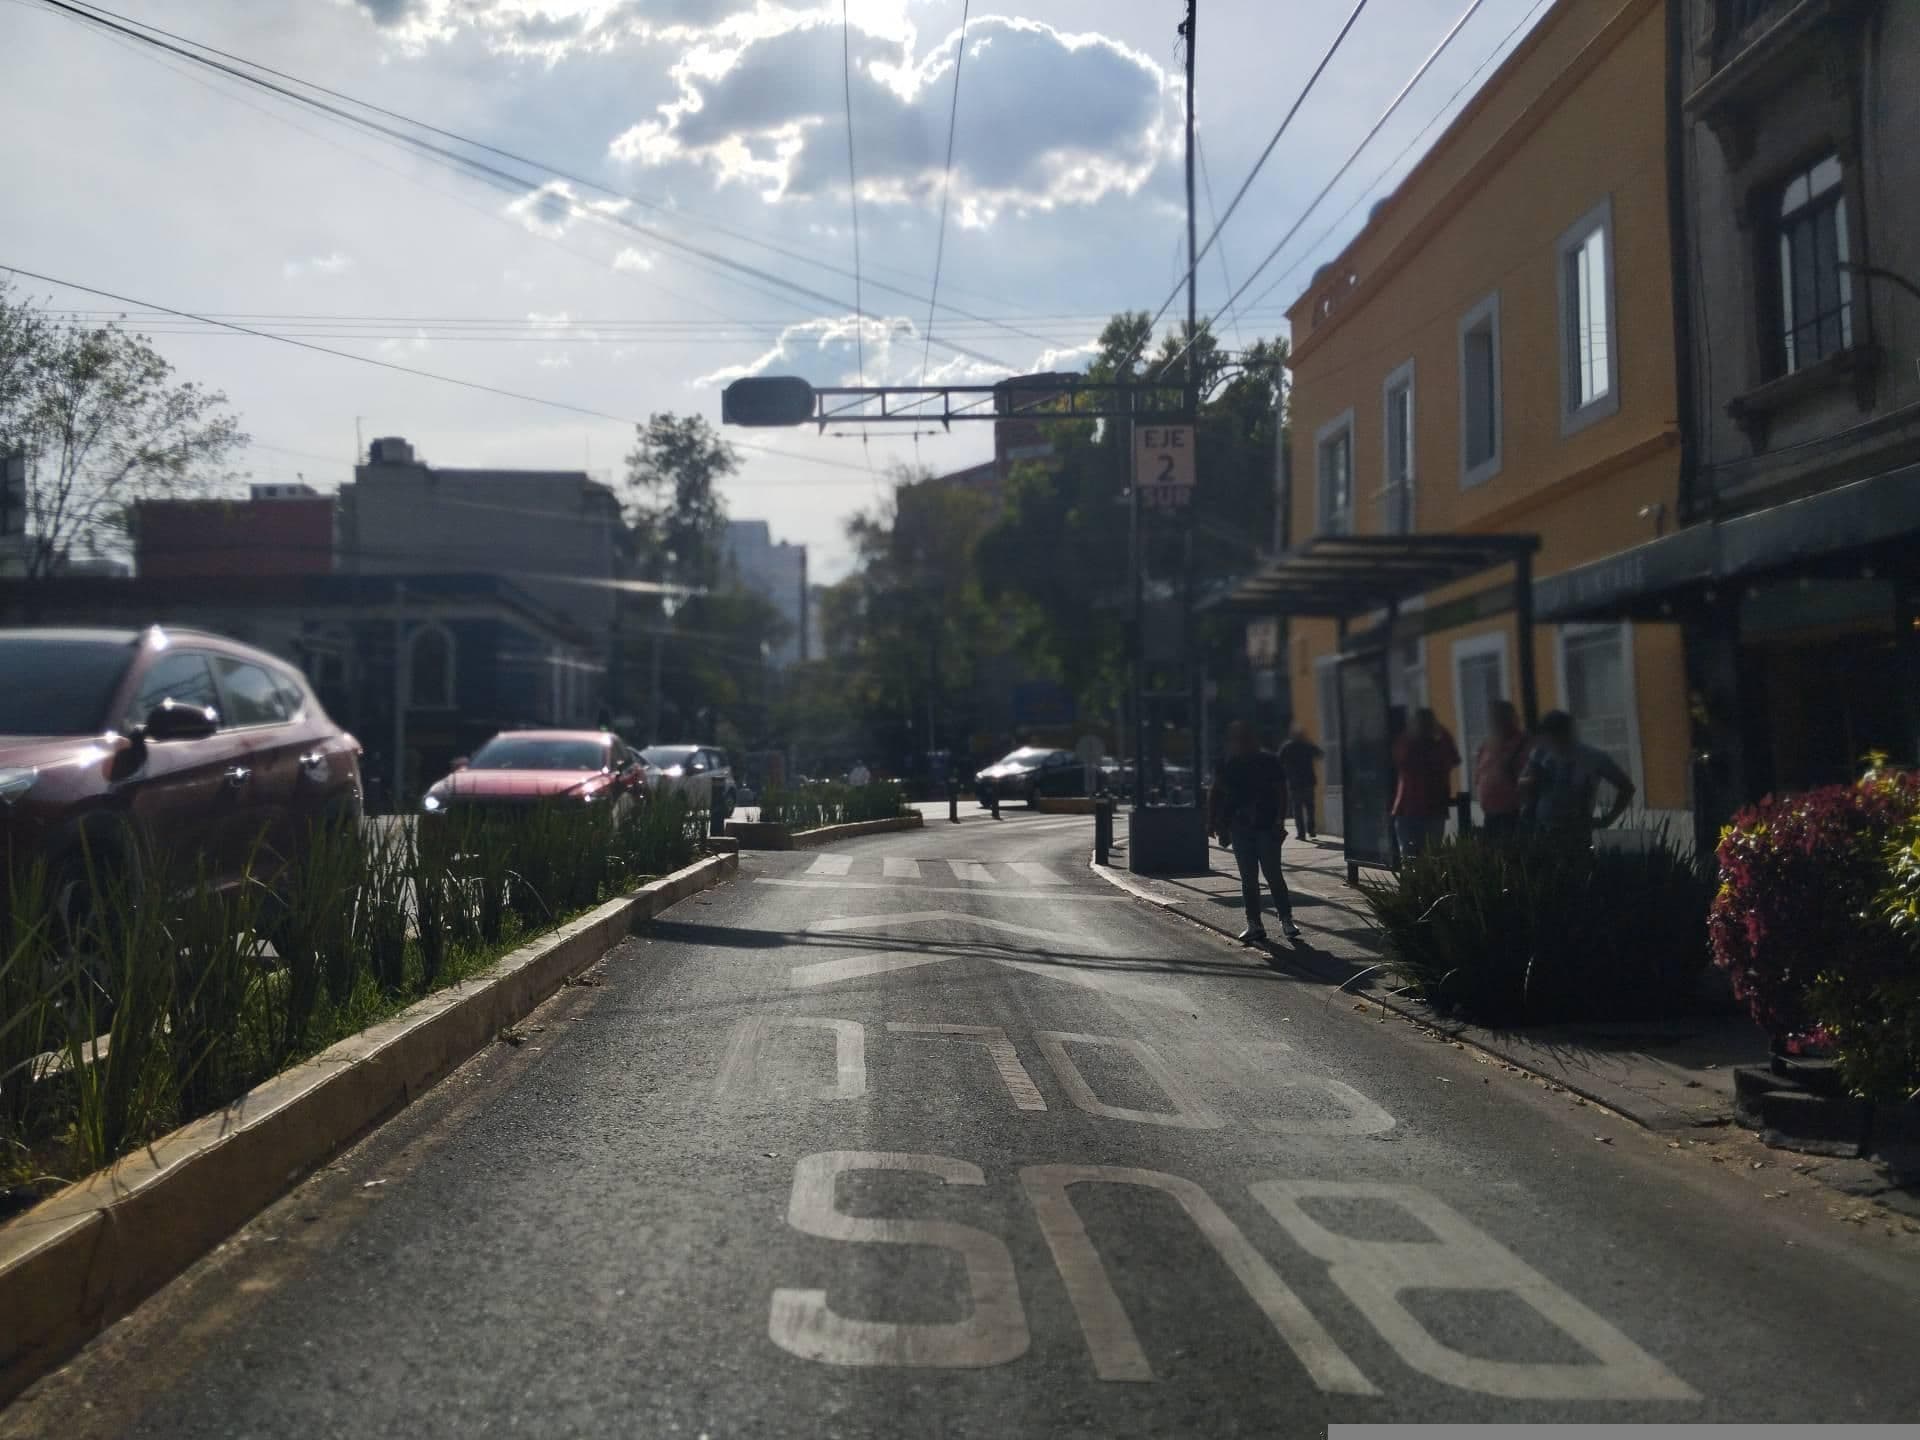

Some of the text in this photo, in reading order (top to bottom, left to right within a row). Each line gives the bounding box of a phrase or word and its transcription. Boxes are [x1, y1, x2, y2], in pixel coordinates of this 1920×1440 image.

[1144, 430, 1185, 448] EJE
[1157, 455, 1177, 481] 2
[1142, 486, 1190, 506] SUR
[769, 1150, 1702, 1401] BUS
